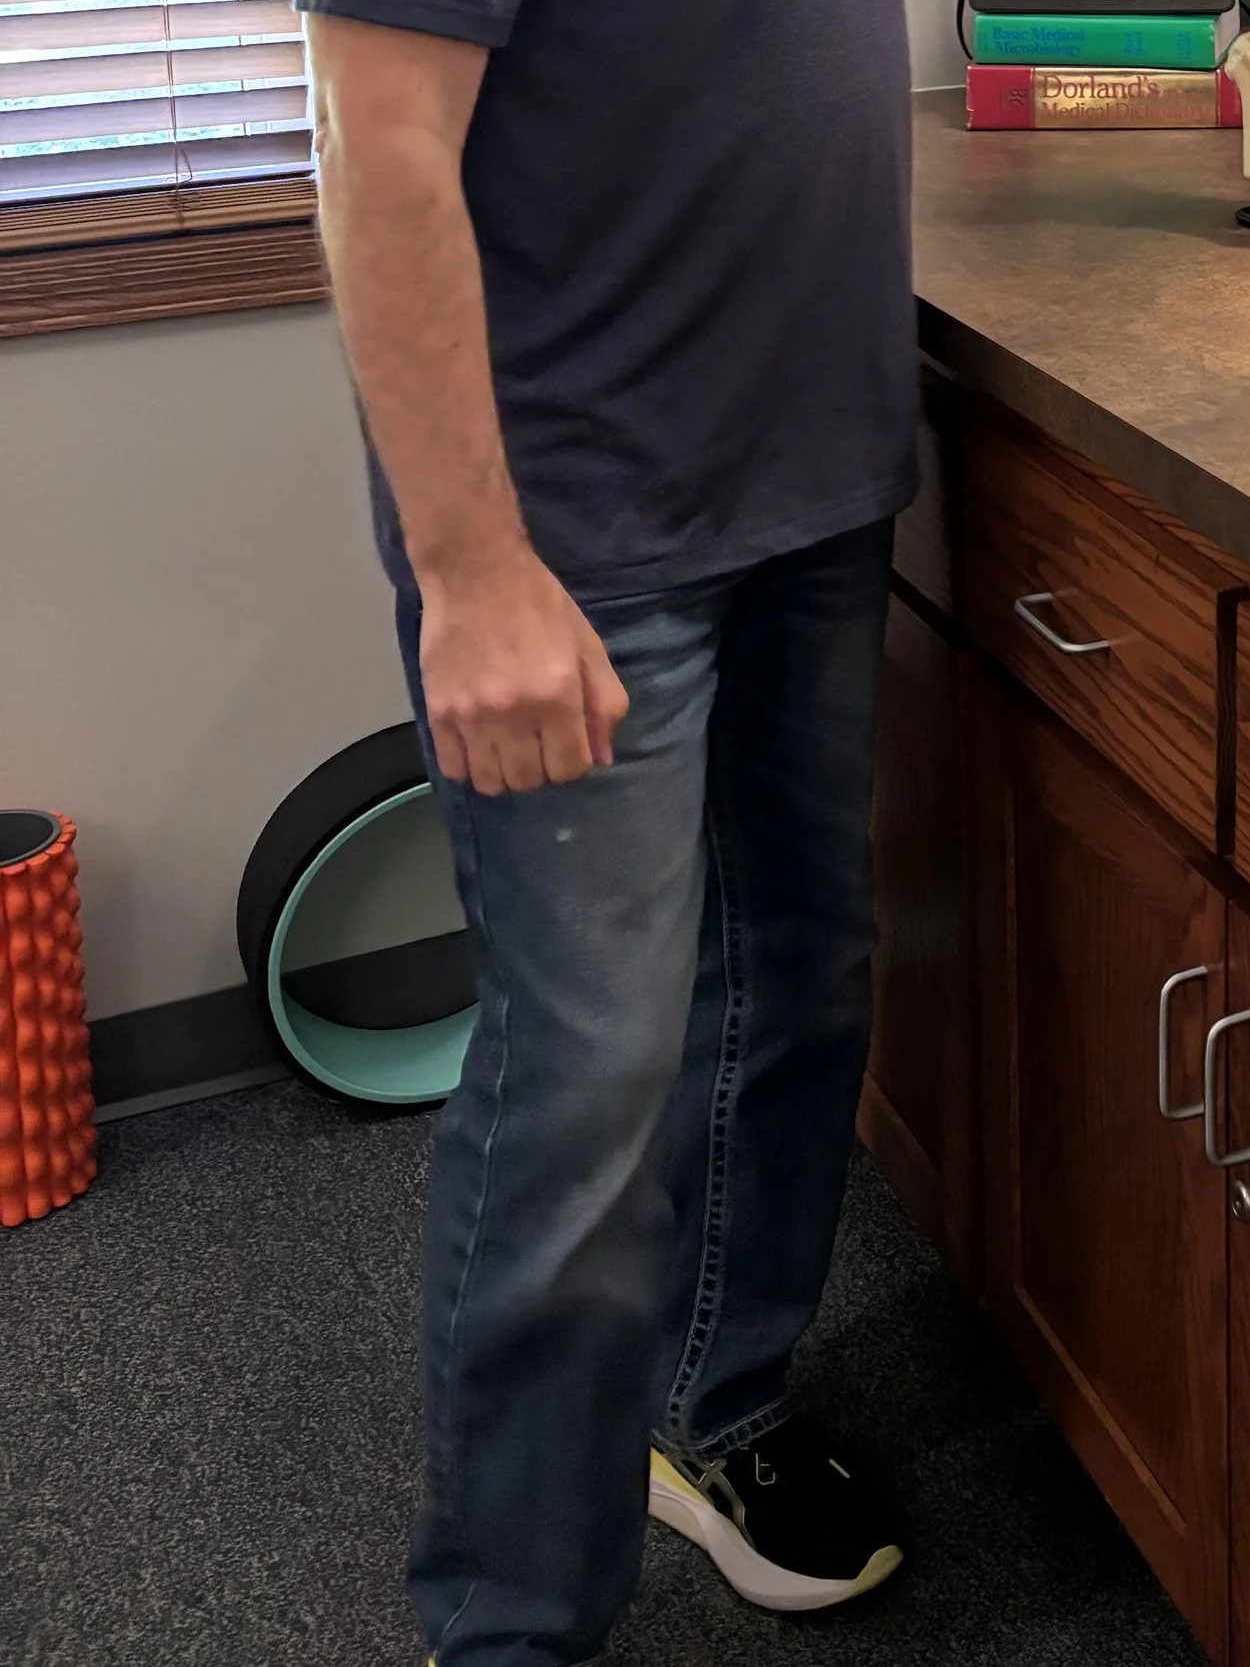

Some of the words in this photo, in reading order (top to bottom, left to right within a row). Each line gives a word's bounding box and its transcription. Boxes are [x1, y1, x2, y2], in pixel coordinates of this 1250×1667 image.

[1032, 27, 1083, 41] Medical
[1042, 74, 1161, 100] Dorland's
[1008, 88, 1028, 109] 28
[1042, 101, 1110, 119] Medical
[1115, 102, 1207, 123] Dictionary
